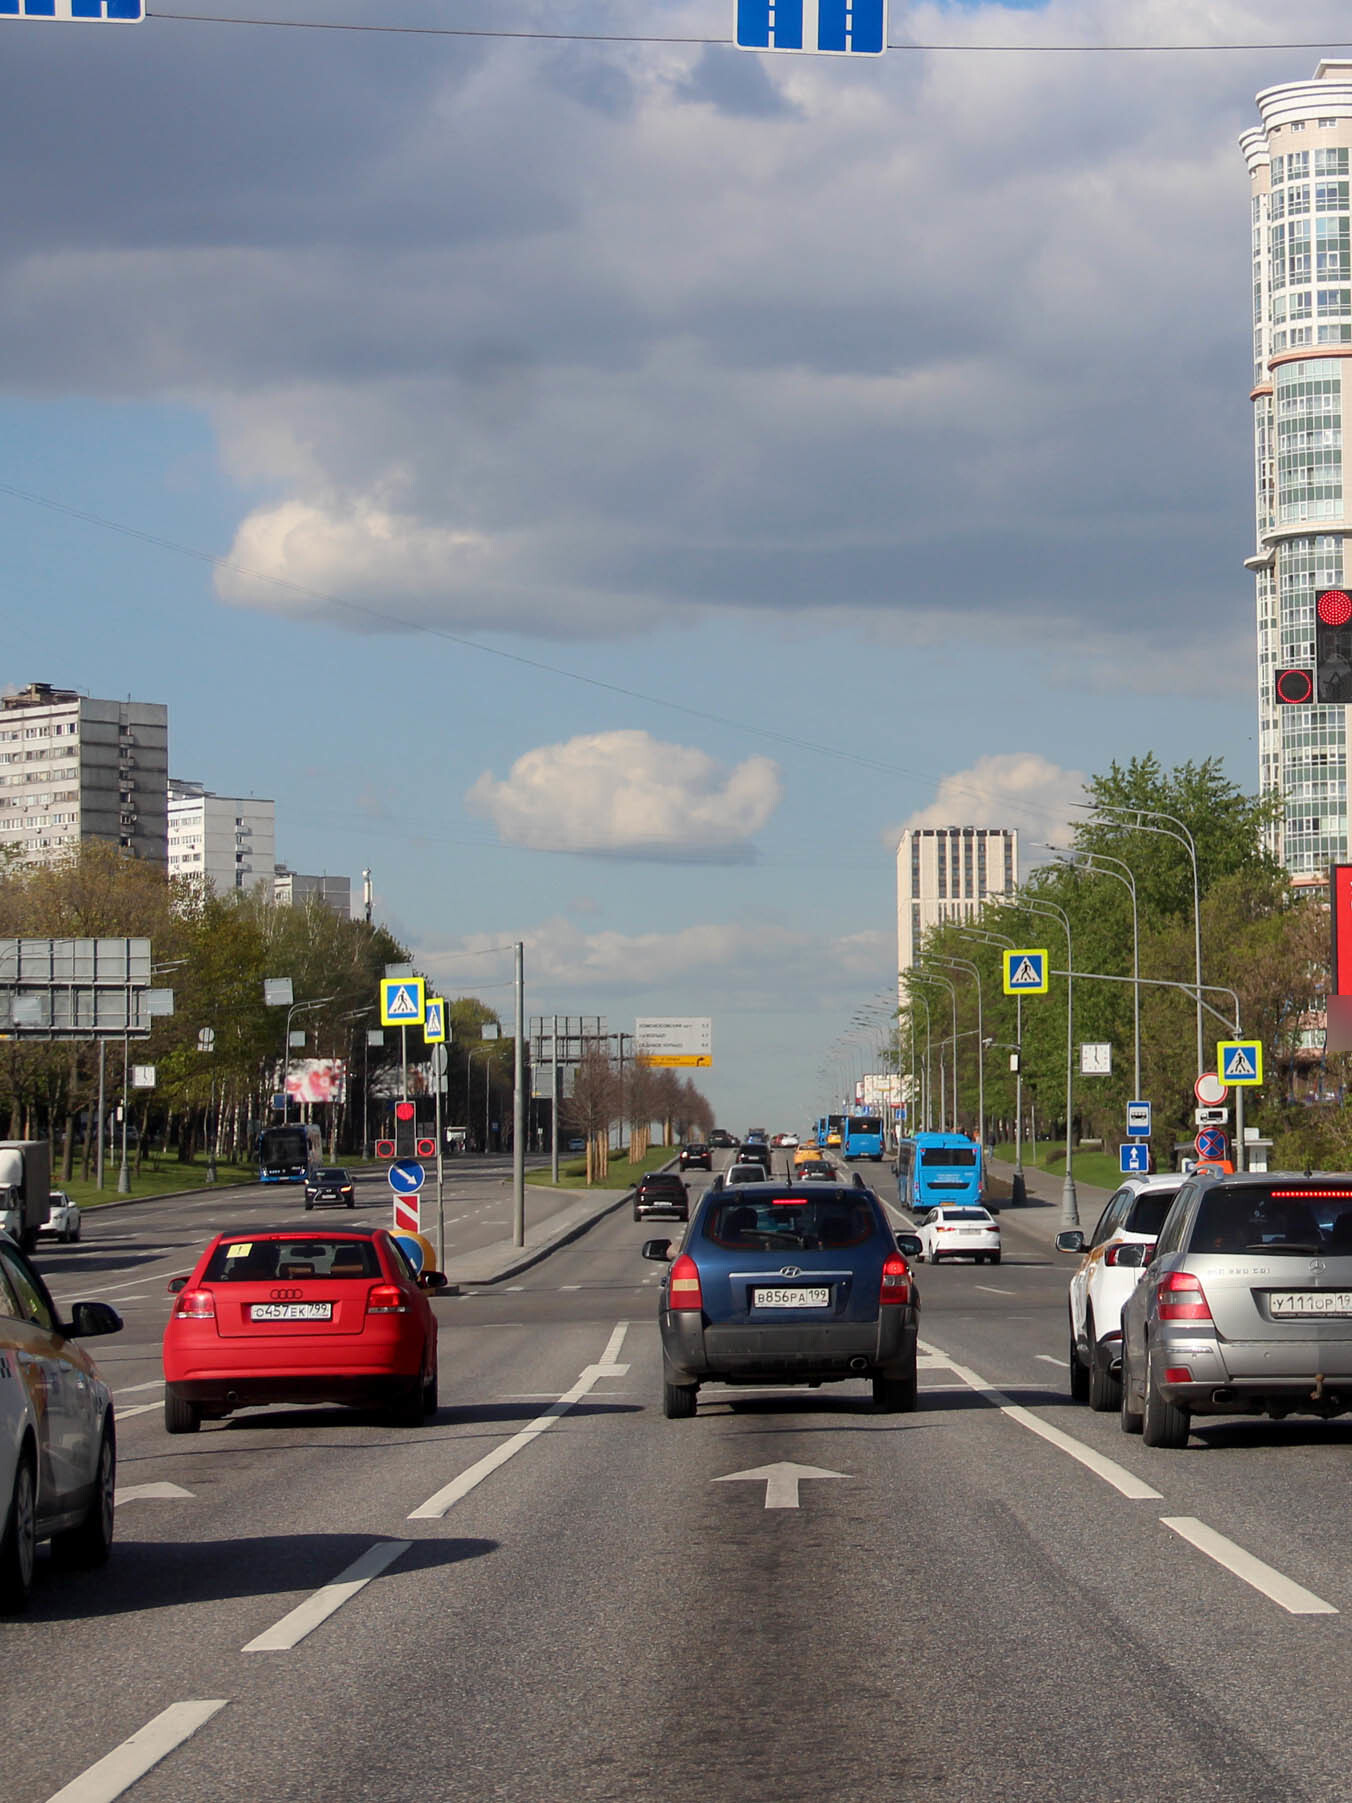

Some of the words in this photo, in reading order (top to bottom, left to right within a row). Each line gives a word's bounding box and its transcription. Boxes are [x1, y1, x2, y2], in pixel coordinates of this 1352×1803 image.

[758, 1291, 805, 1303] В856РА
[808, 1290, 826, 1300] 199
[255, 1304, 306, 1318] О457ЕК
[307, 1303, 327, 1313] 799
